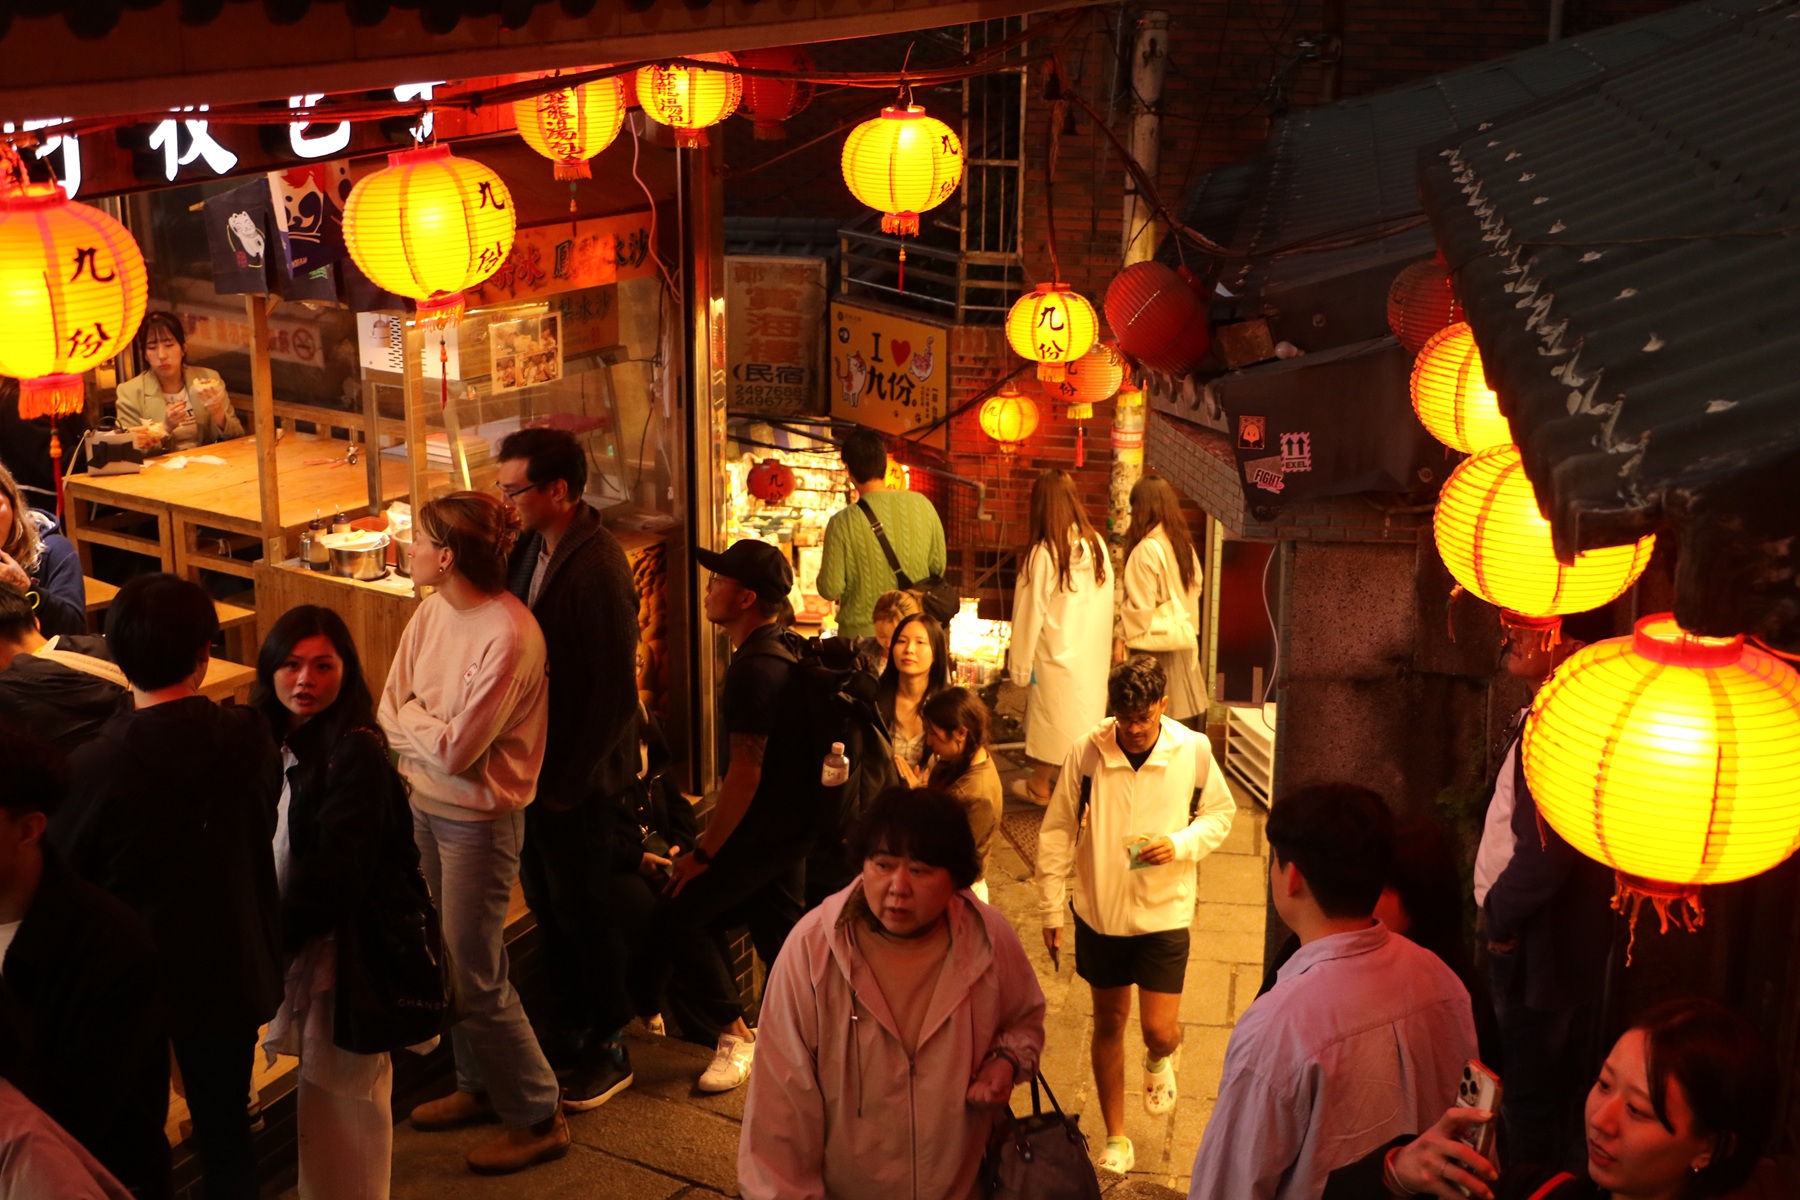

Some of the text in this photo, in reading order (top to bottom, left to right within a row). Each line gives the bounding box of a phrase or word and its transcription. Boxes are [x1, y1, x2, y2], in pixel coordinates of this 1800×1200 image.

[937, 135, 958, 199] 九份
[477, 181, 506, 274] 九份
[68, 247, 115, 358] 九份
[871, 332, 883, 363] I
[1038, 306, 1065, 360] 九份
[1254, 469, 1282, 487] FIGHT
[1285, 461, 1307, 469] EXEL
